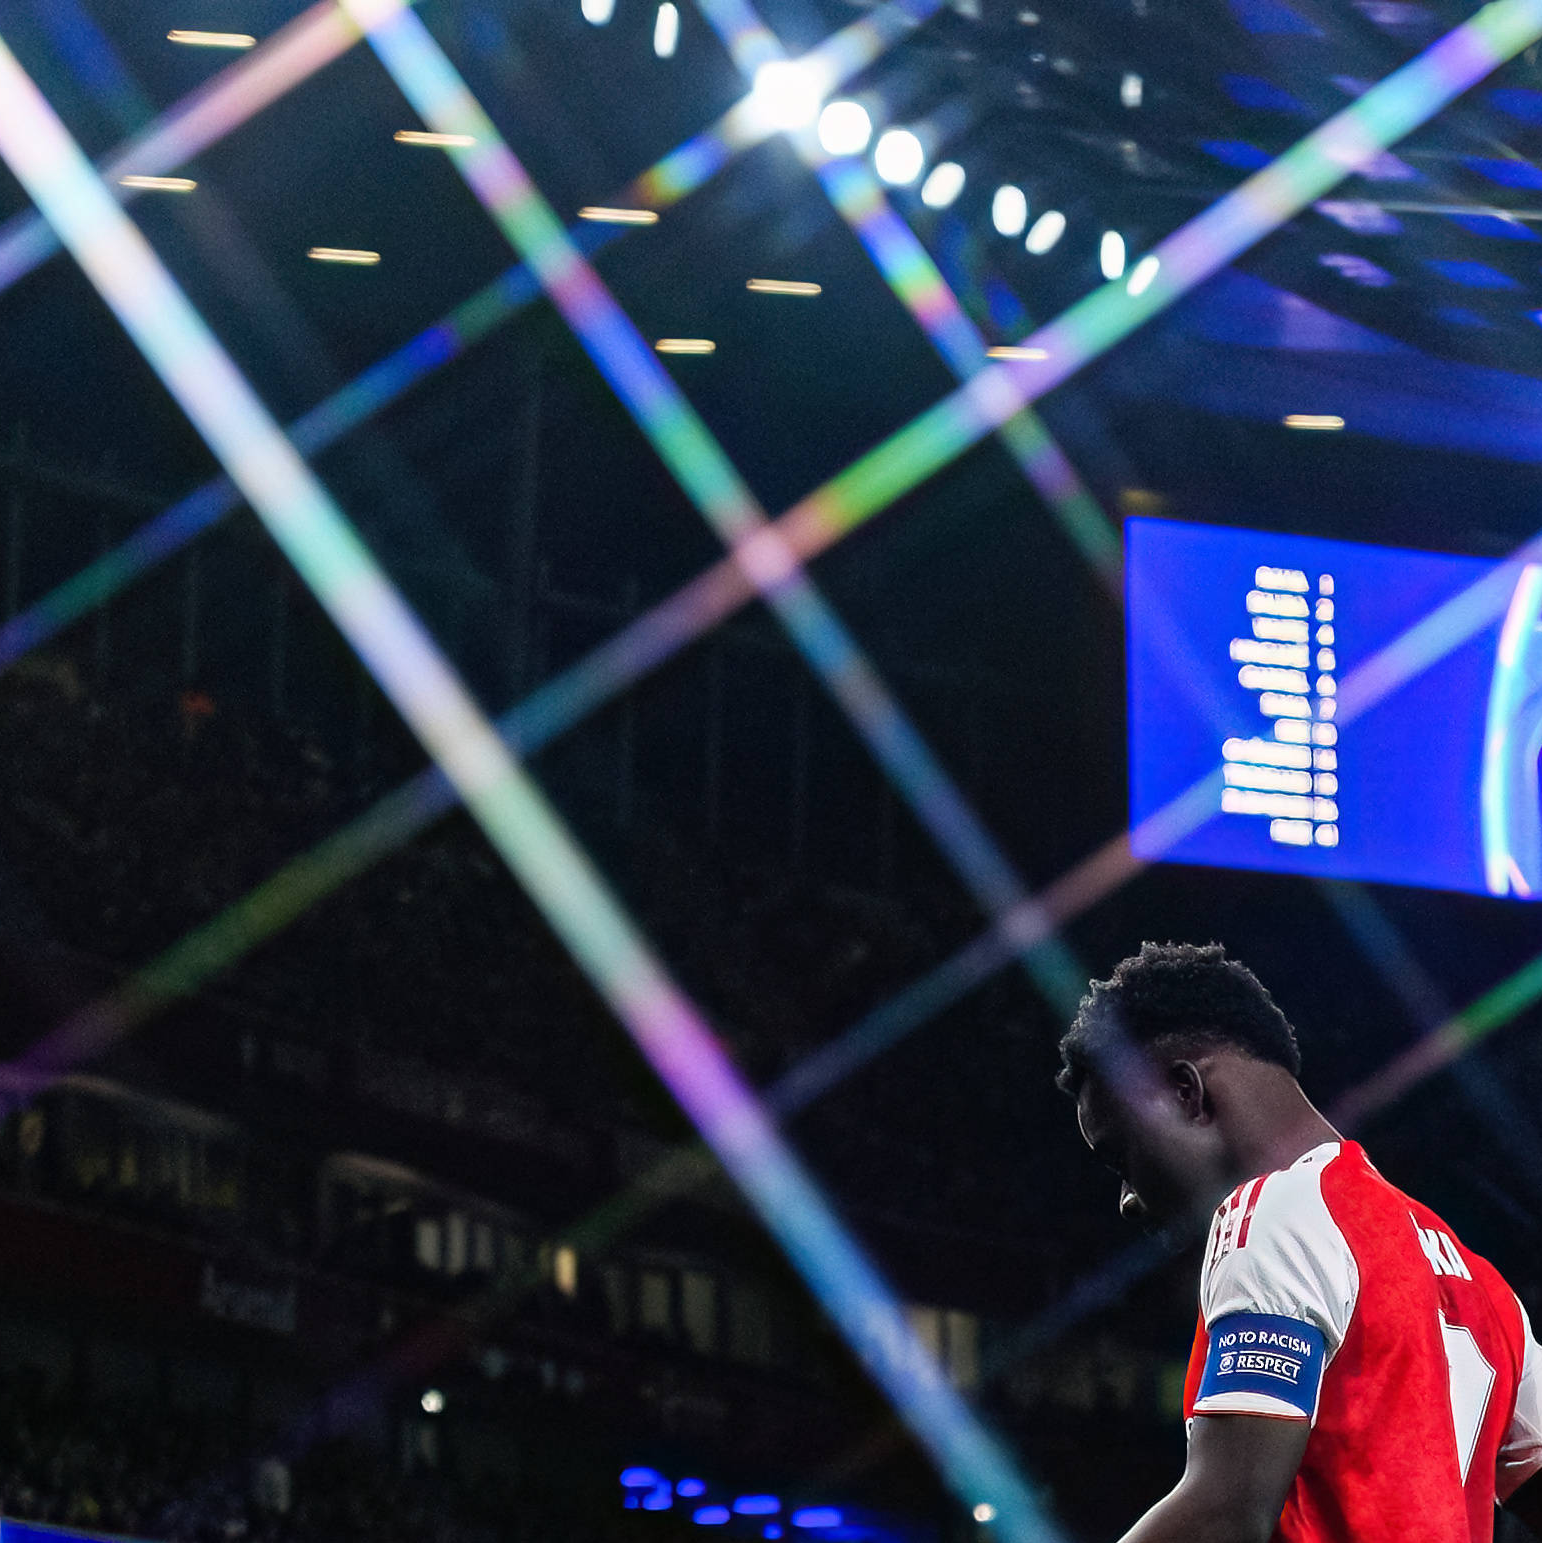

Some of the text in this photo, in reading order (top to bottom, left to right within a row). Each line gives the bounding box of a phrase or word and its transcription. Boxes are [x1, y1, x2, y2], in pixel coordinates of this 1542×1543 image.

[1409, 1210, 1473, 1281] KA
[1219, 1331, 1311, 1357] NO TO RACISM
[1237, 1355, 1301, 1379] RESPECT
